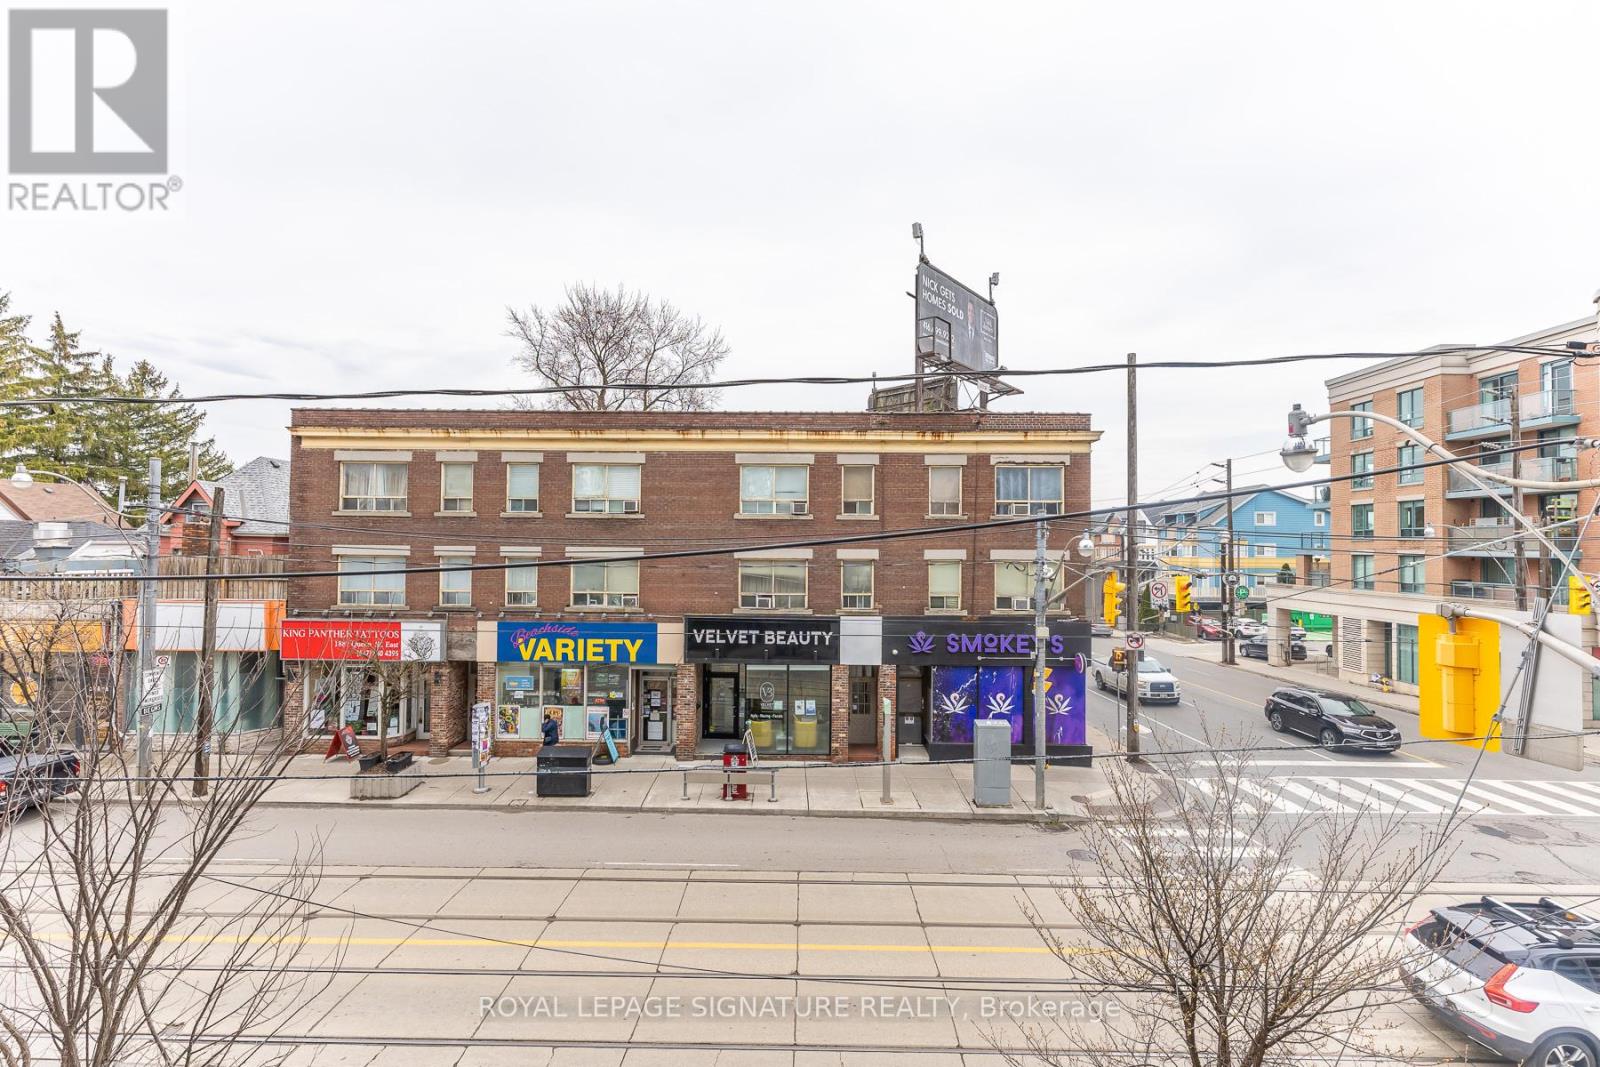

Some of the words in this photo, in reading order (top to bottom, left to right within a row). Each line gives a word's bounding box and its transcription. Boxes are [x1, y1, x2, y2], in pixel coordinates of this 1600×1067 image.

[922, 274, 939, 293] NICK
[940, 285, 956, 303] GETS
[922, 288, 947, 311] HOMES
[947, 303, 965, 320] SOLD
[282, 629, 306, 638] KING
[308, 629, 352, 638] PANTHER
[353, 630, 400, 639] TATTOOS
[692, 628, 760, 645] VELVET
[764, 630, 834, 646] BEAUTY
[518, 637, 645, 662] VARIETY
